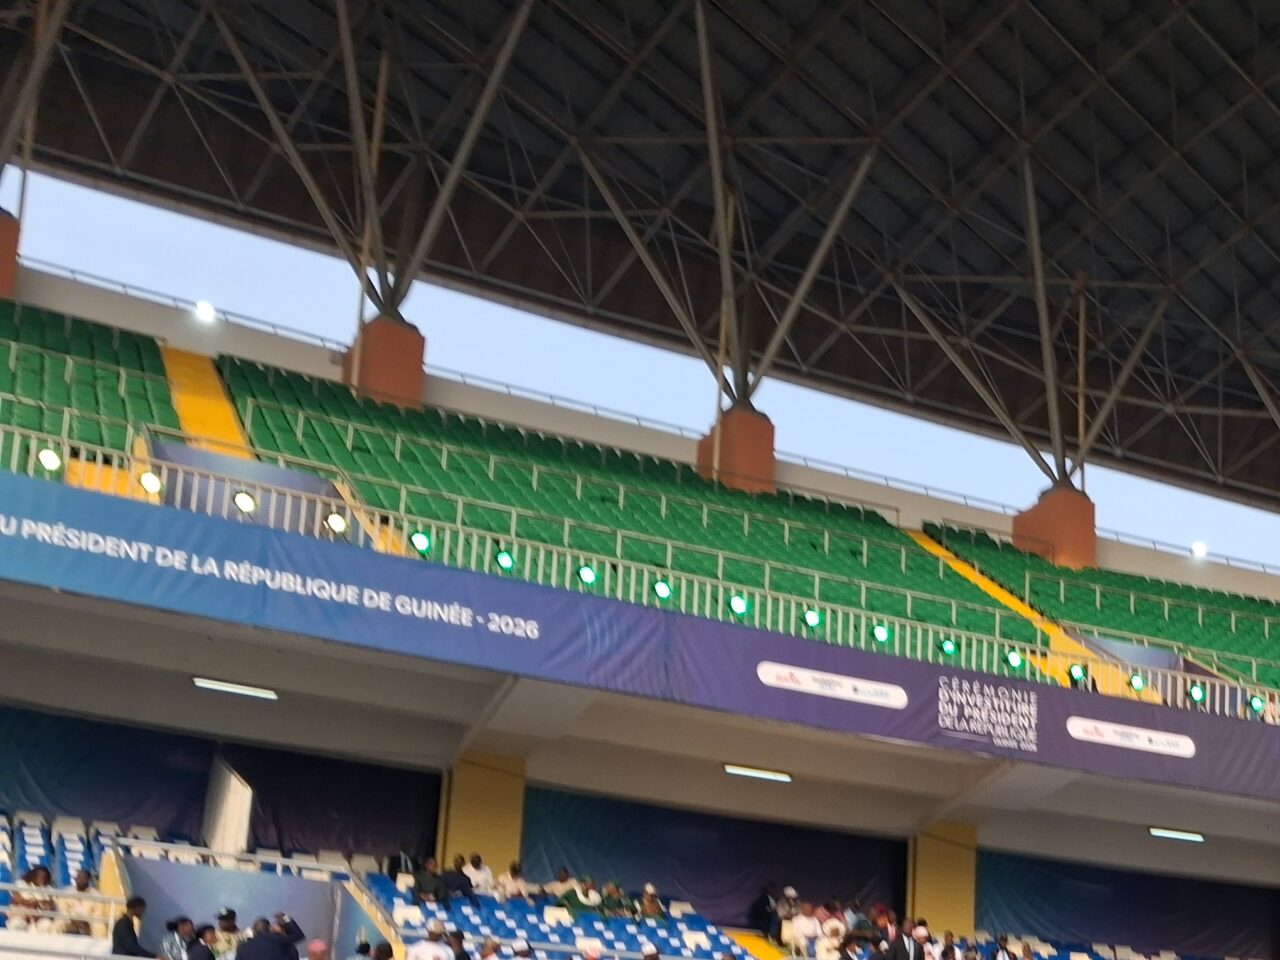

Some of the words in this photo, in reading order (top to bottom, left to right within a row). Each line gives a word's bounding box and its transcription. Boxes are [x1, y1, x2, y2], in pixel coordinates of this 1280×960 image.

[0, 514, 17, 536] U
[21, 518, 153, 563] PRÉSIDENT
[155, 547, 187, 571] DE
[191, 554, 220, 578] LA
[223, 560, 359, 606] RÉPUBLIQUE
[362, 588, 391, 612] DE
[395, 595, 473, 627] GUINÉE
[487, 612, 539, 640] 2026
